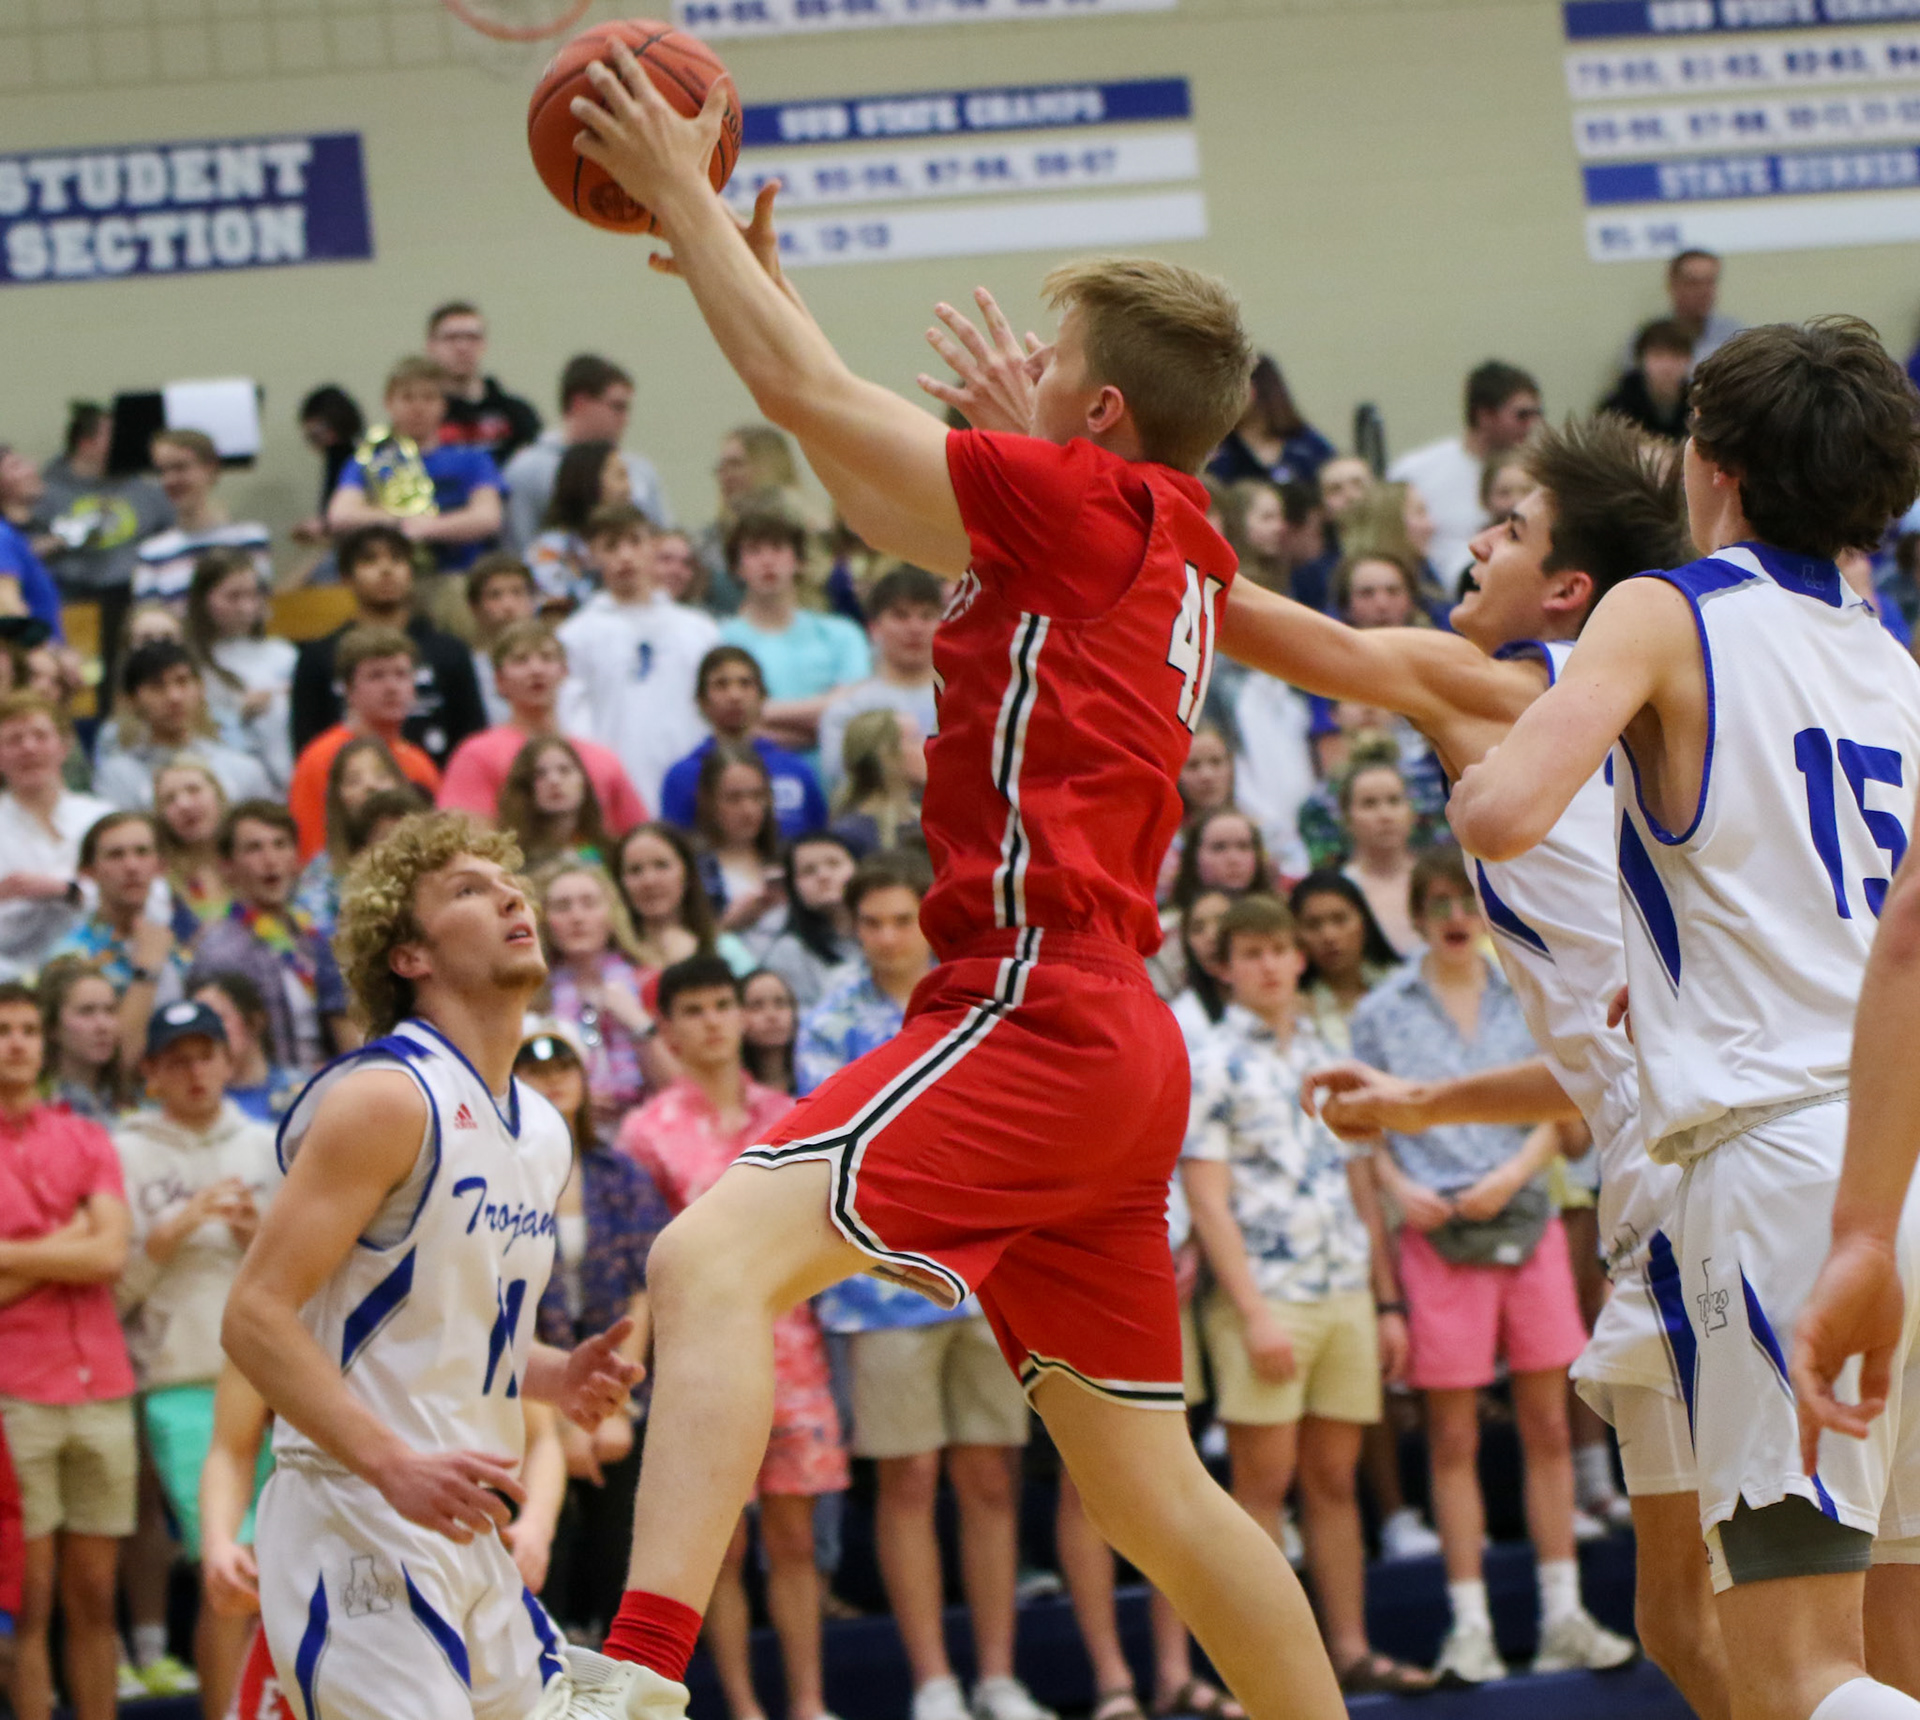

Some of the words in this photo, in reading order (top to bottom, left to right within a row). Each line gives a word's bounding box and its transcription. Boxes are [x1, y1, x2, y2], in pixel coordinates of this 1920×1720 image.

[0, 142, 311, 217] STUDENT
[1658, 161, 1769, 199] STATE
[5, 203, 306, 280] SECTION
[1167, 560, 1226, 734] 41
[1794, 727, 1908, 920] 15
